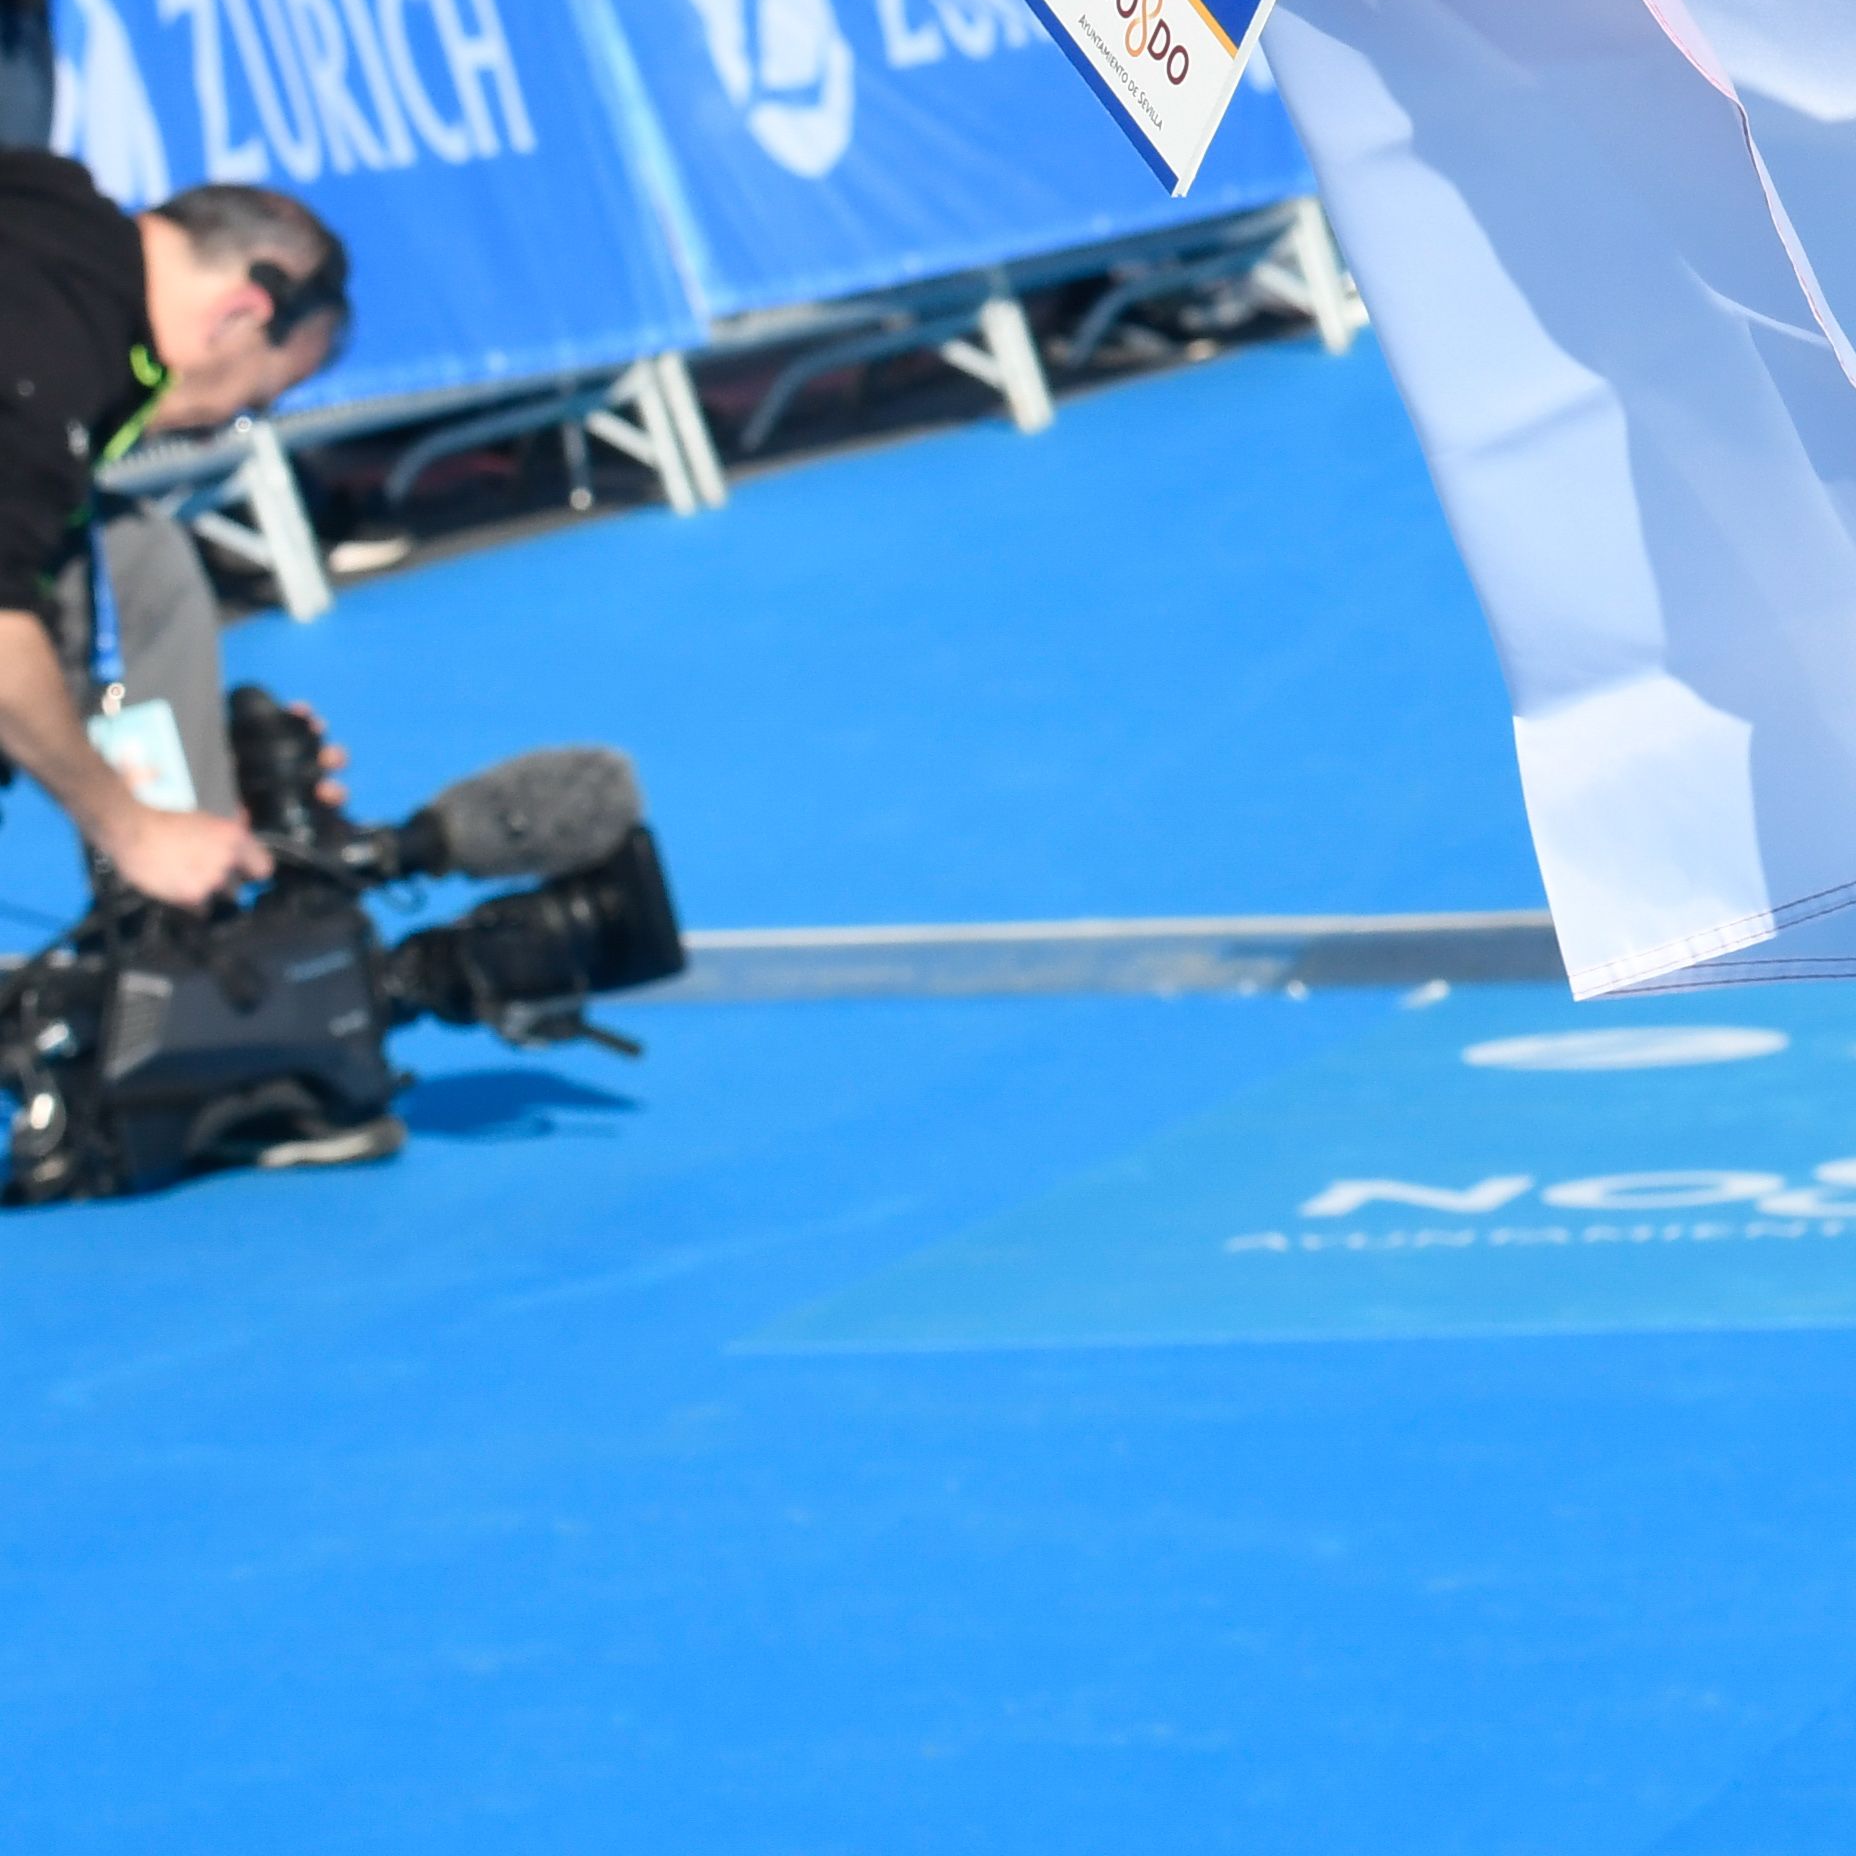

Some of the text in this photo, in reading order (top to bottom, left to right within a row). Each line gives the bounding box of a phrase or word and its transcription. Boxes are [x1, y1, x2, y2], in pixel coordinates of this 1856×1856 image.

[1077, 13, 1164, 132] AYUNTAMIENTO DE SEVILLA
